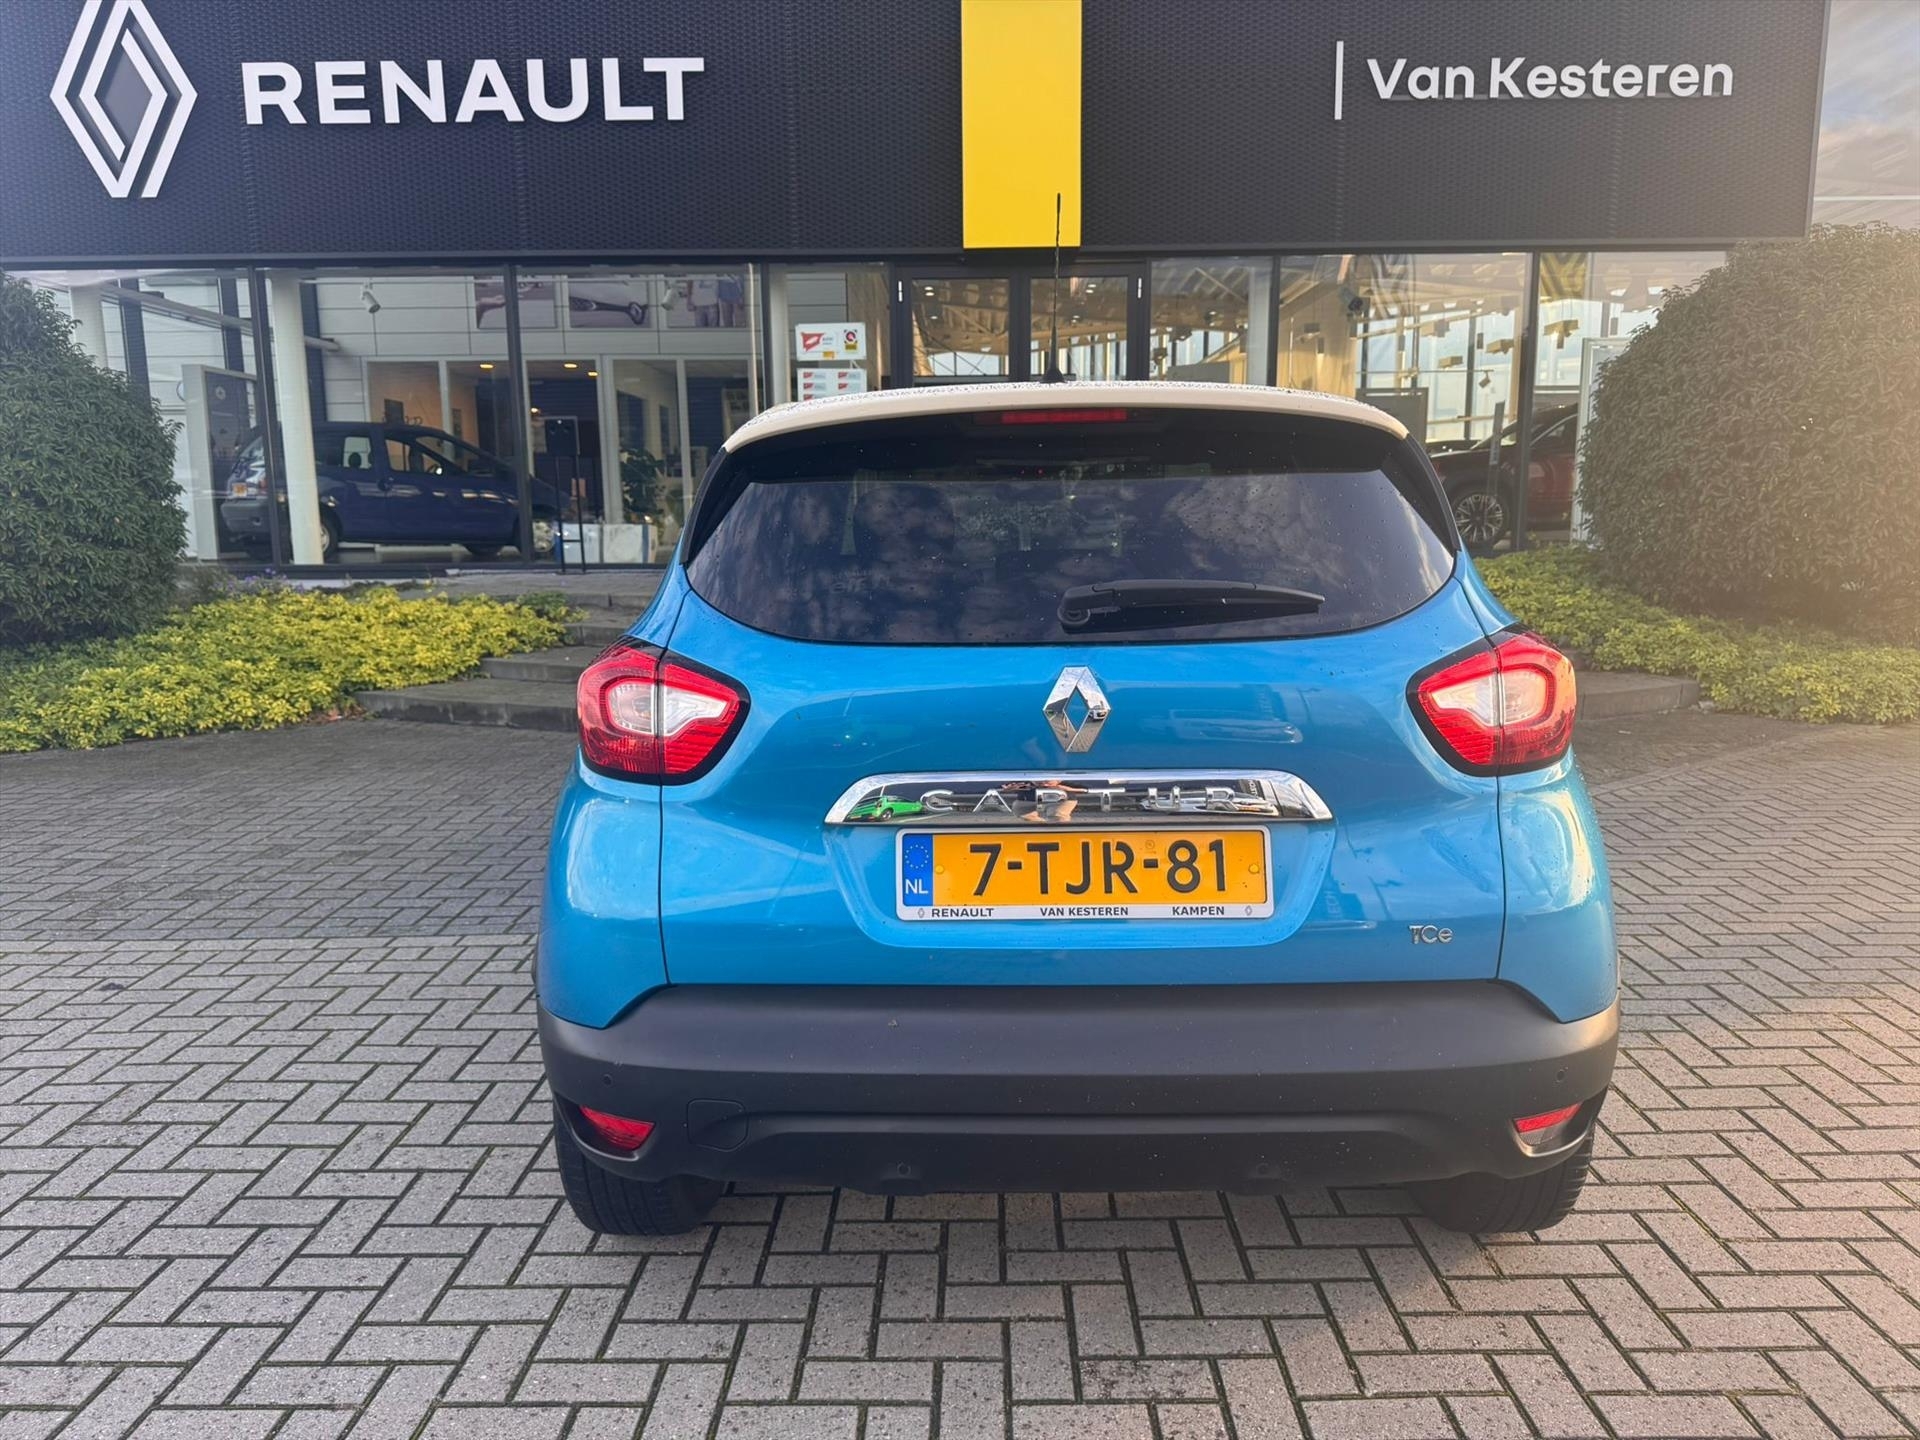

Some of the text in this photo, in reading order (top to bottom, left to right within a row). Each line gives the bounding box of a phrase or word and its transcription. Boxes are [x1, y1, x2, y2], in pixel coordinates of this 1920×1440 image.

[242, 57, 705, 125] RENAULT
[1367, 57, 1734, 99] Van Kesteren
[920, 786, 1236, 812] CAPTUR
[969, 839, 1226, 896] 7-TJR-81
[905, 878, 929, 894] NL
[931, 906, 1225, 918] RENAULT VAN KESTEREN KAMPEN
[1408, 924, 1453, 945] TCe
